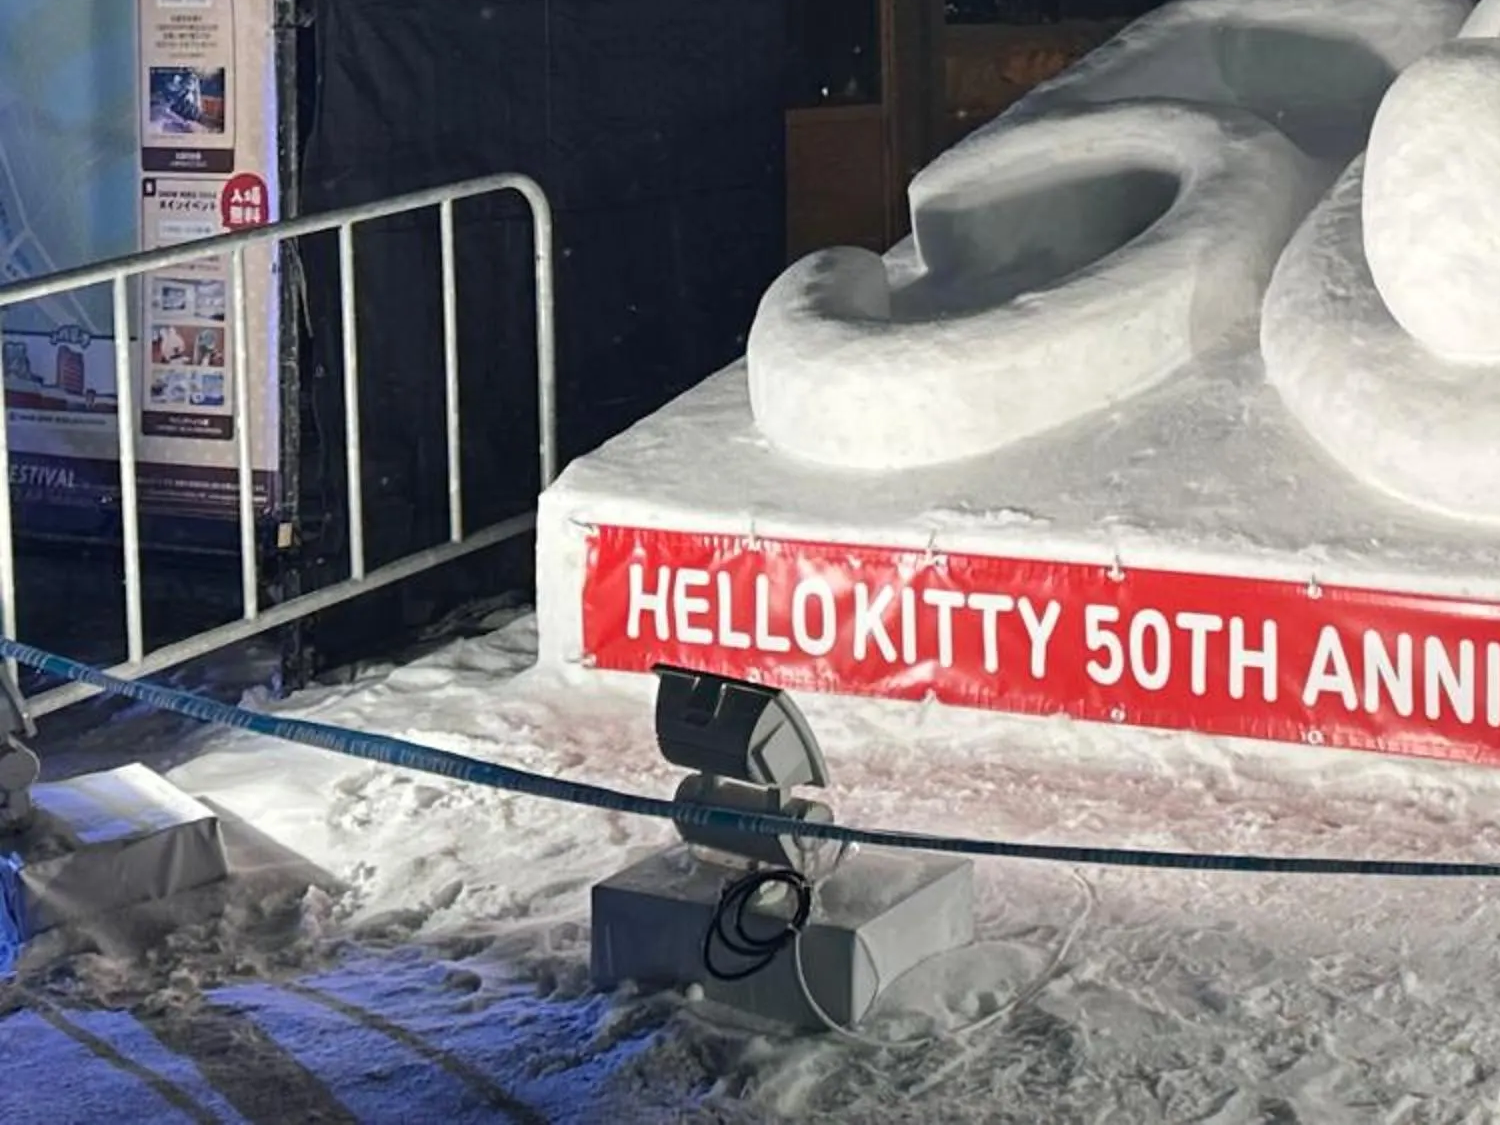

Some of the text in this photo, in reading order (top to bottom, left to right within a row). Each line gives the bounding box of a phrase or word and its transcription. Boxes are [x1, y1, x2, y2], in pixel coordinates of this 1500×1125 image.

[8, 464, 76, 488] ESTIVAL
[626, 563, 837, 657] HELLO
[852, 581, 1060, 679] KITTY
[1085, 604, 1279, 703] 50TH
